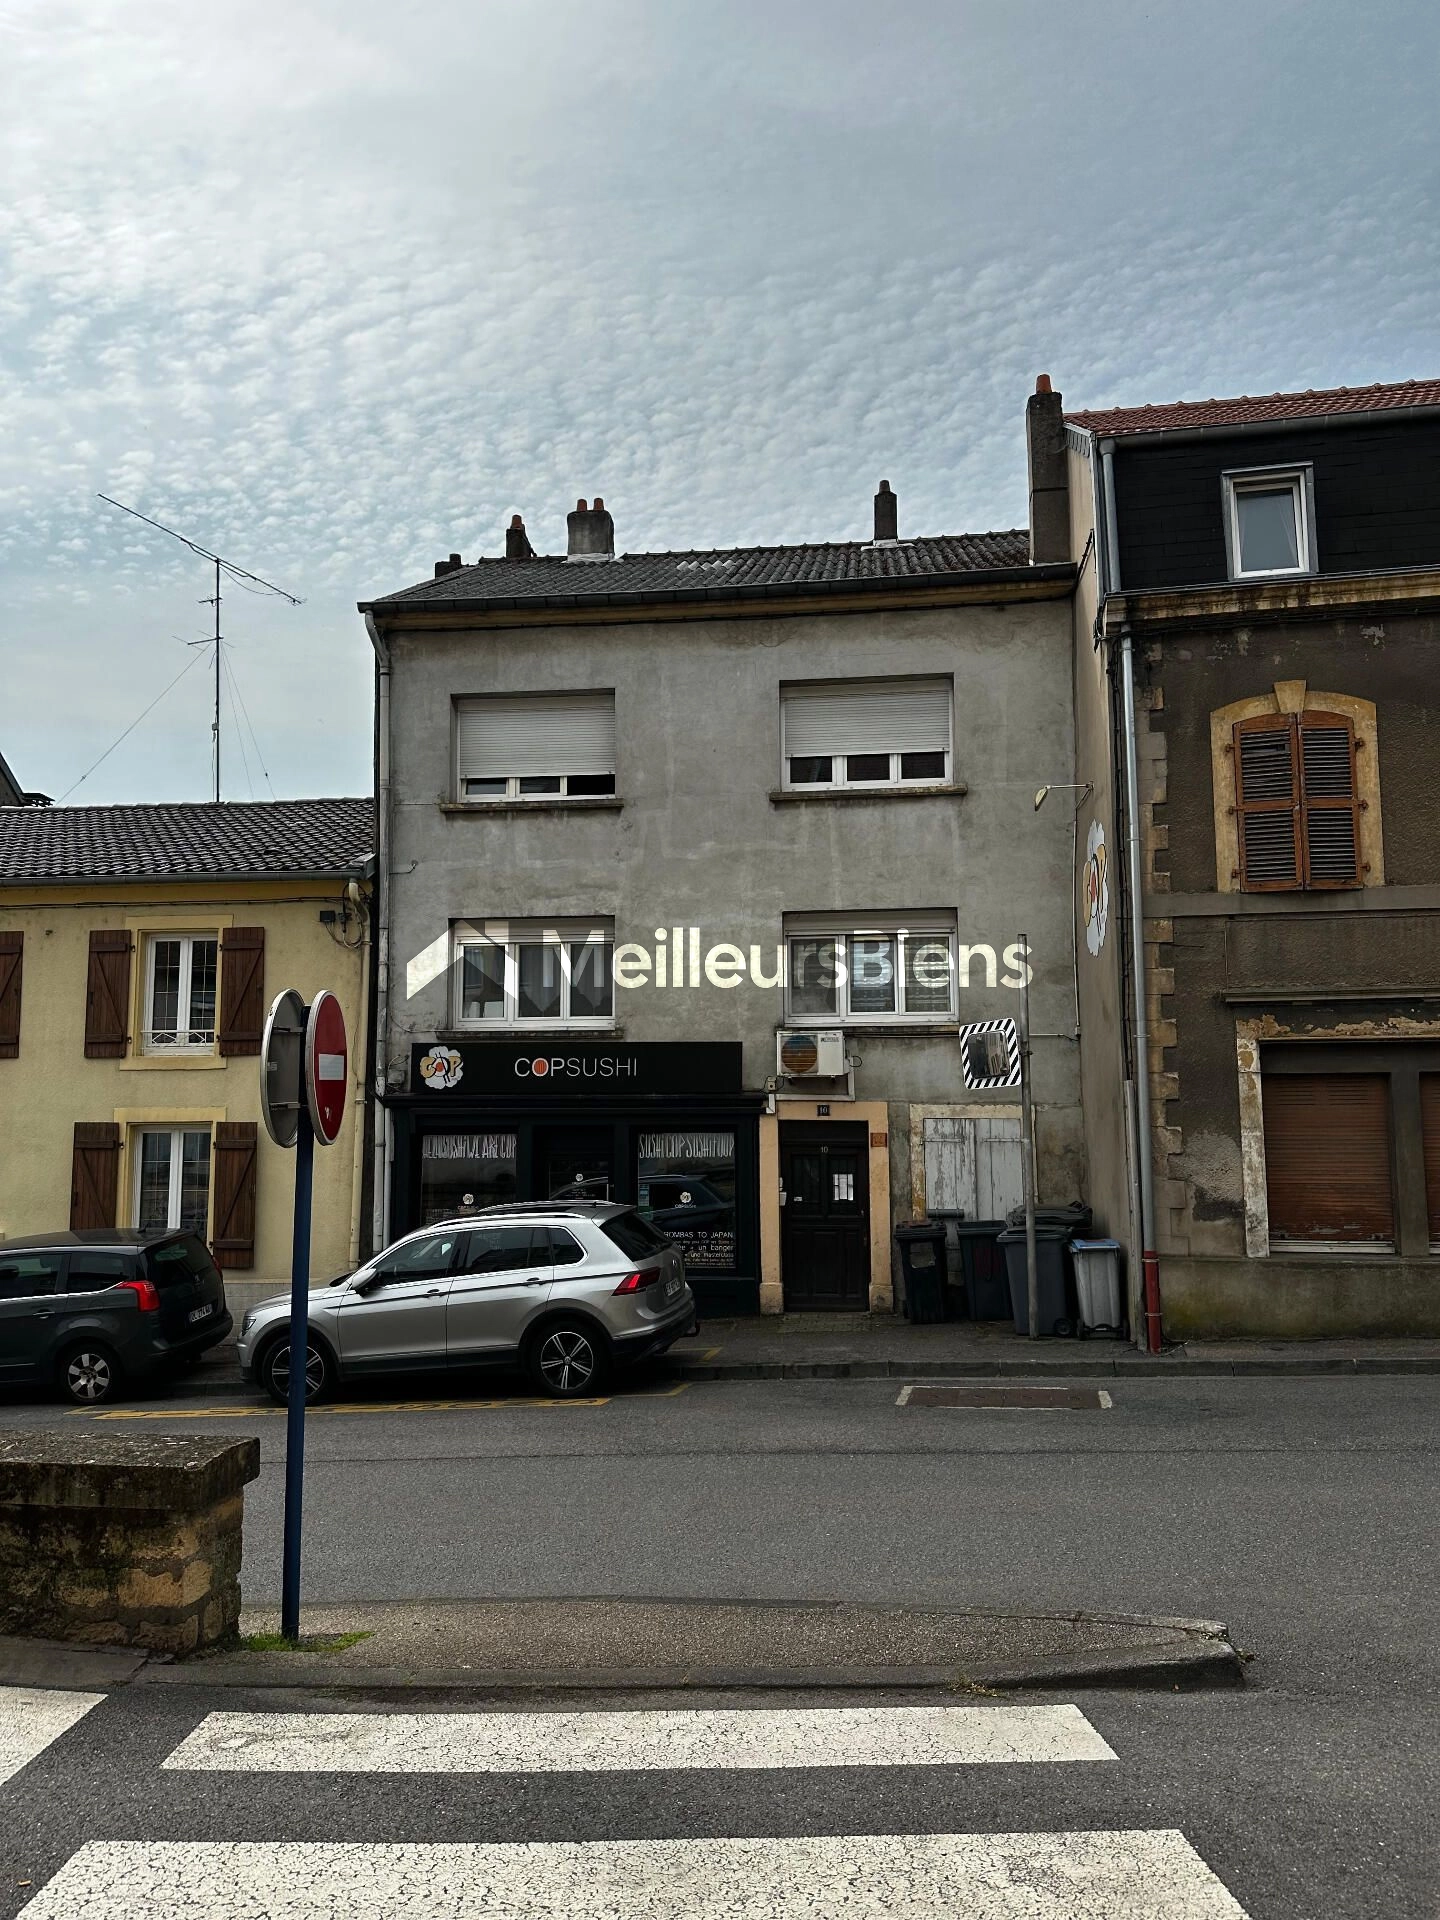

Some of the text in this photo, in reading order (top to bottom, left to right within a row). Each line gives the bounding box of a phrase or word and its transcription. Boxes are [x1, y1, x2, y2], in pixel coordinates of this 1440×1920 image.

[514, 1057, 638, 1077] COPSUSHI
[697, 1231, 708, 1239] TO
[710, 1231, 734, 1239] JAPAN
[710, 1244, 734, 1252] banger
